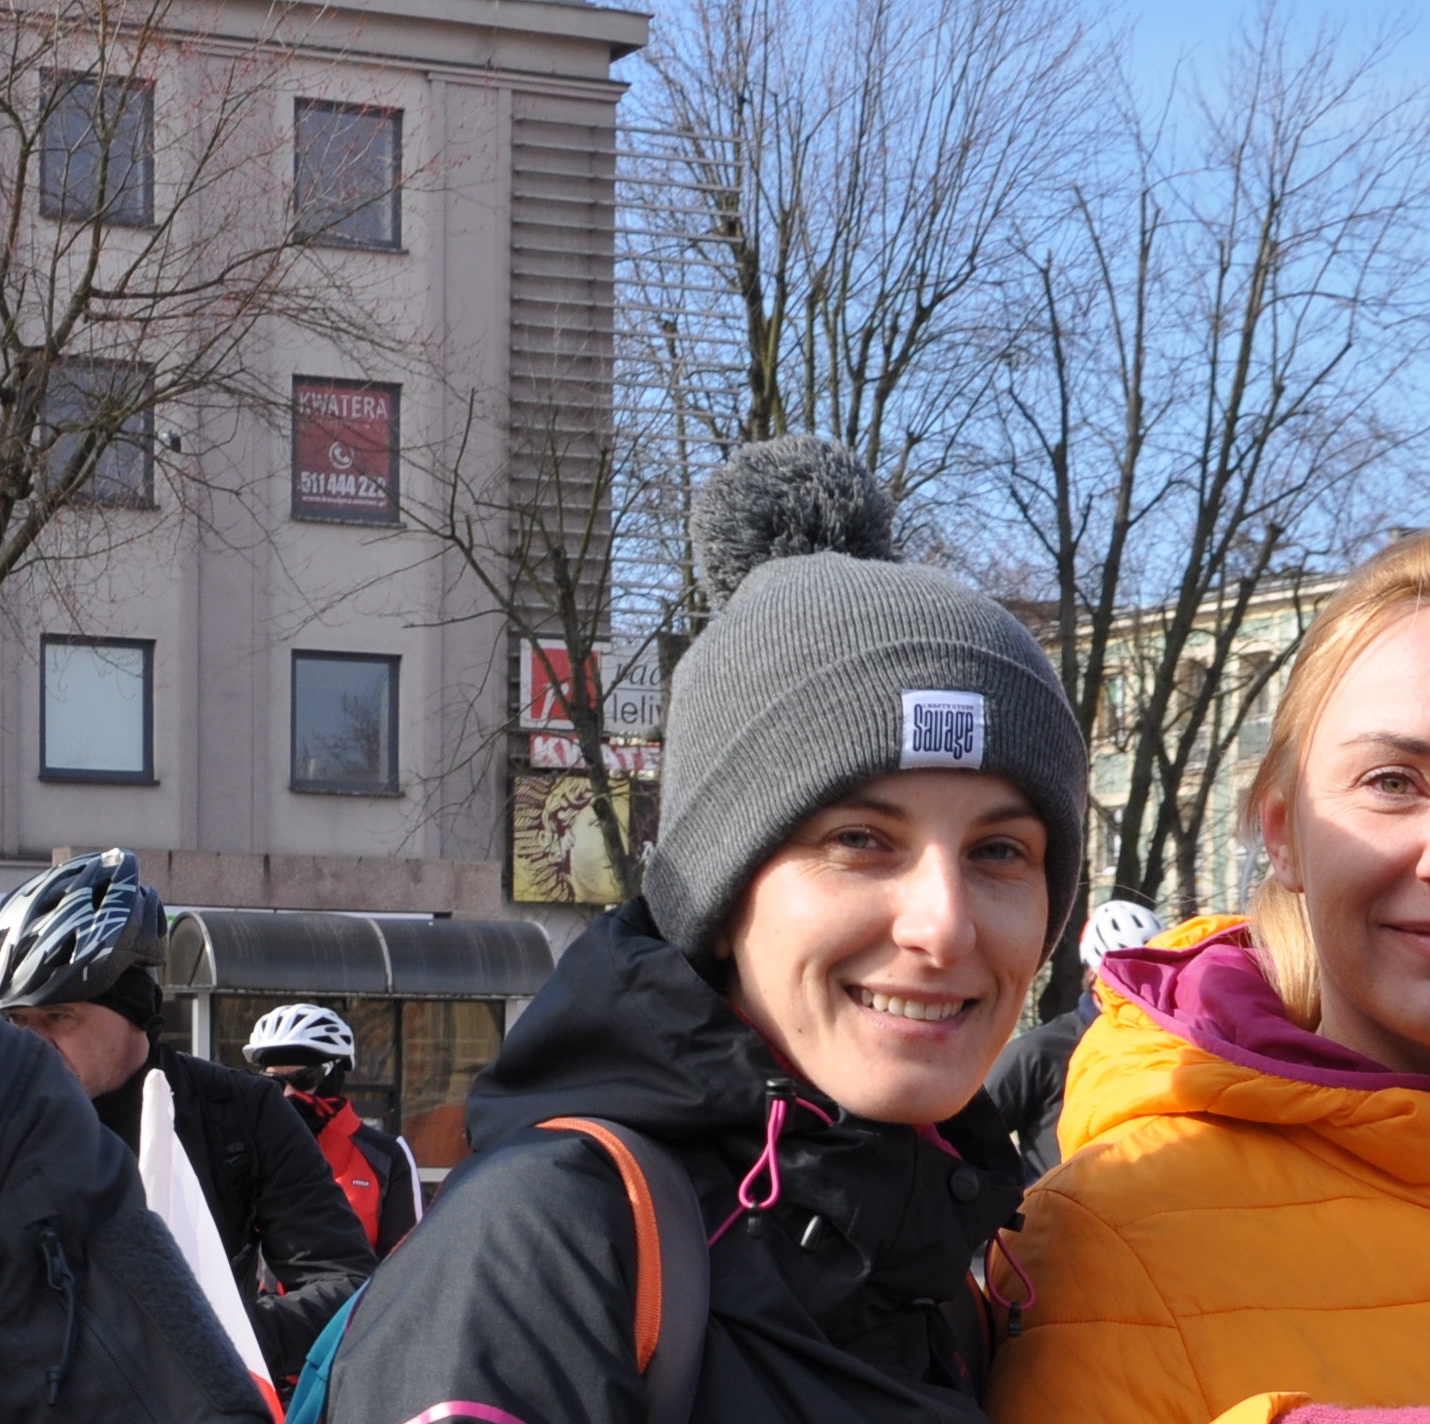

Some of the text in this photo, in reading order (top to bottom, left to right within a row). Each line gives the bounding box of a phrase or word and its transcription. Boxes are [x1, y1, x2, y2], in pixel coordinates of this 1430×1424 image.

[299, 391, 388, 419] KWATERA
[300, 470, 325, 494] 511
[327, 473, 356, 496] 444
[913, 703, 973, 760] Savage
